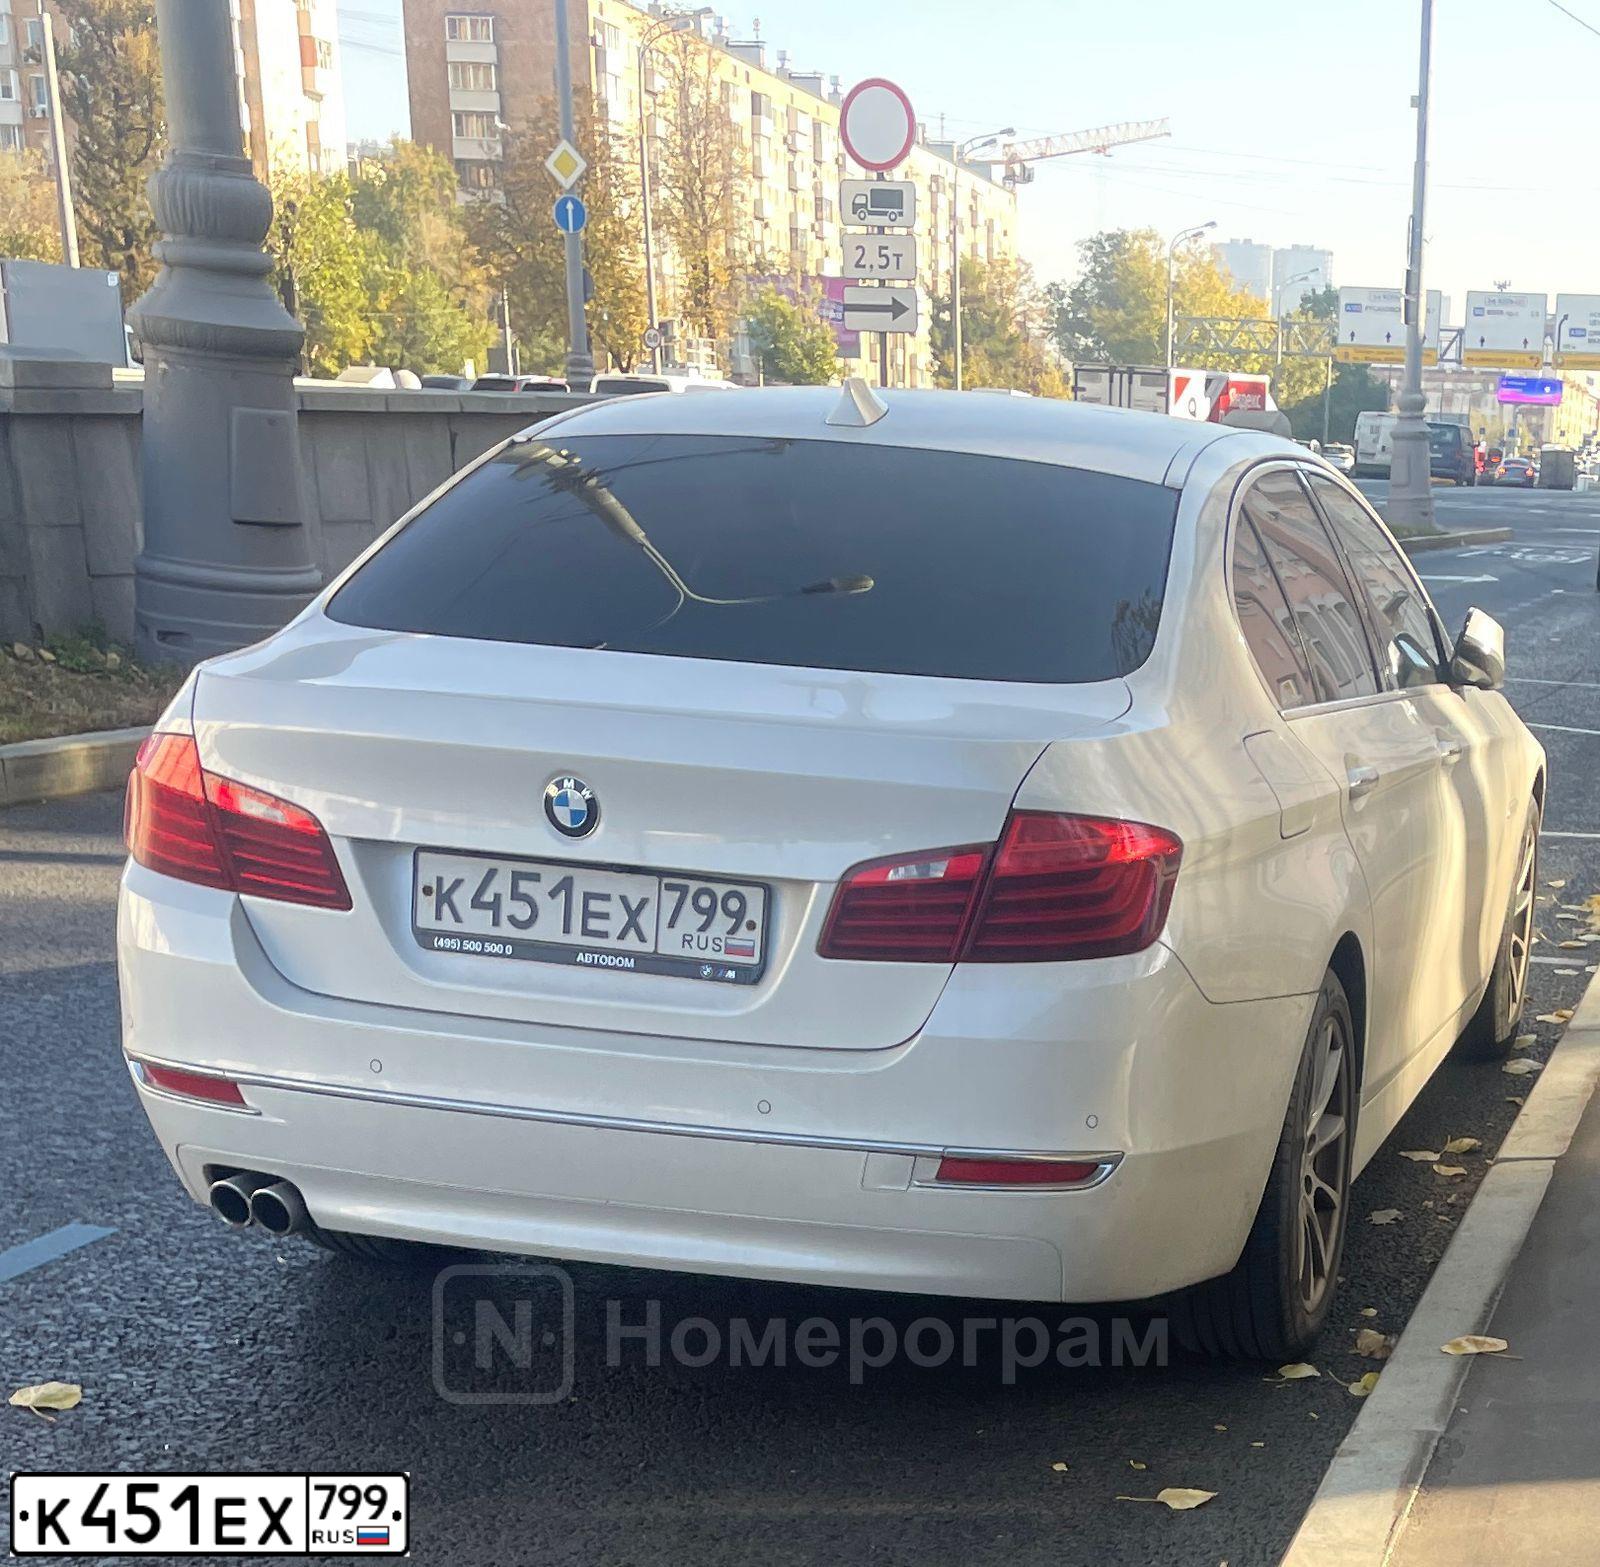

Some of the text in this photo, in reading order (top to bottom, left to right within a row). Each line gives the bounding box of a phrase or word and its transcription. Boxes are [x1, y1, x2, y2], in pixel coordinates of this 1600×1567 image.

[664, 882, 748, 936] 799
[433, 936, 461, 951] (495)
[462, 940, 482, 952] 500
[483, 942, 504, 954] 500
[681, 933, 723, 952] RUS
